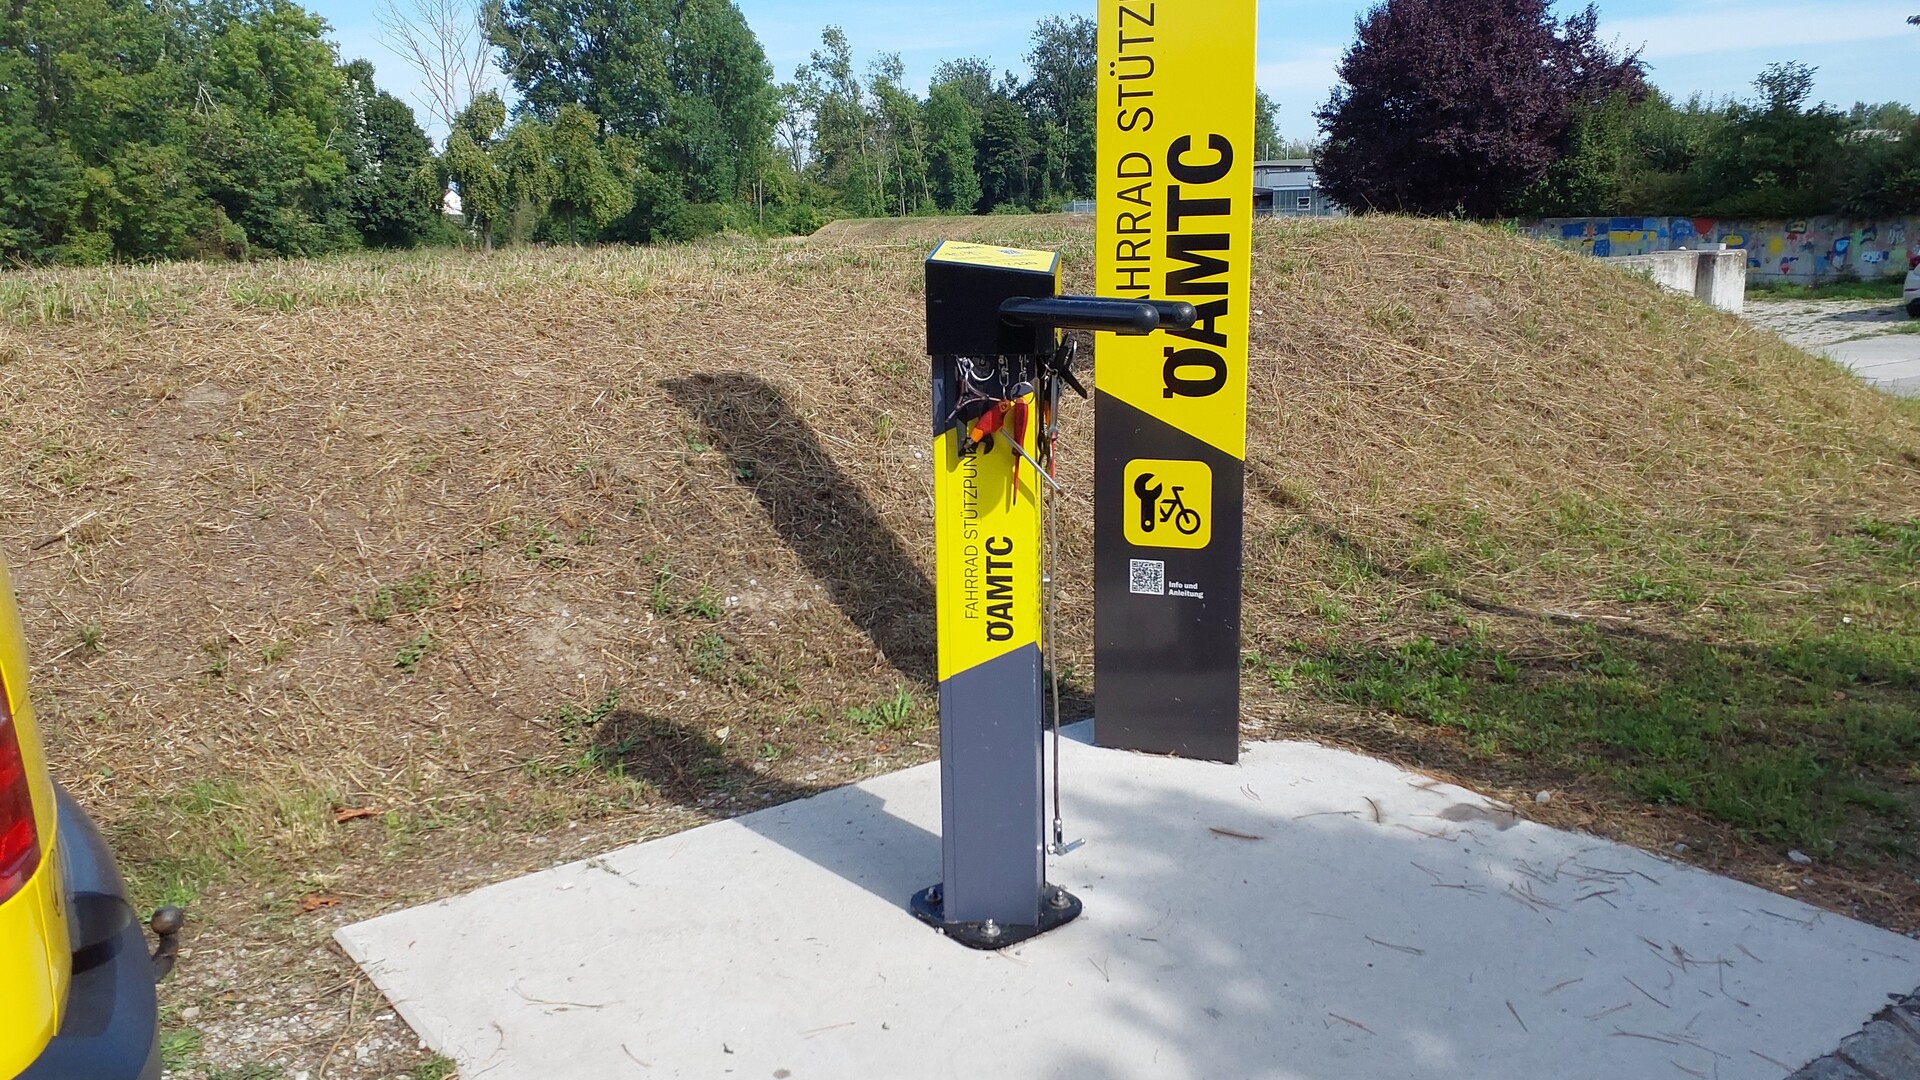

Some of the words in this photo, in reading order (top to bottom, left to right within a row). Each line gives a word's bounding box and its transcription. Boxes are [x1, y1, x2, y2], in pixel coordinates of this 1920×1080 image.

[1110, 0, 1154, 132] STÜTZ
[1115, 151, 1153, 336] HRRAD
[1162, 133, 1233, 398] ÖAMTC
[964, 545, 979, 619] FAHRRAD
[985, 536, 1013, 642] ÖAMTC
[1168, 589, 1204, 599] Anleitung
